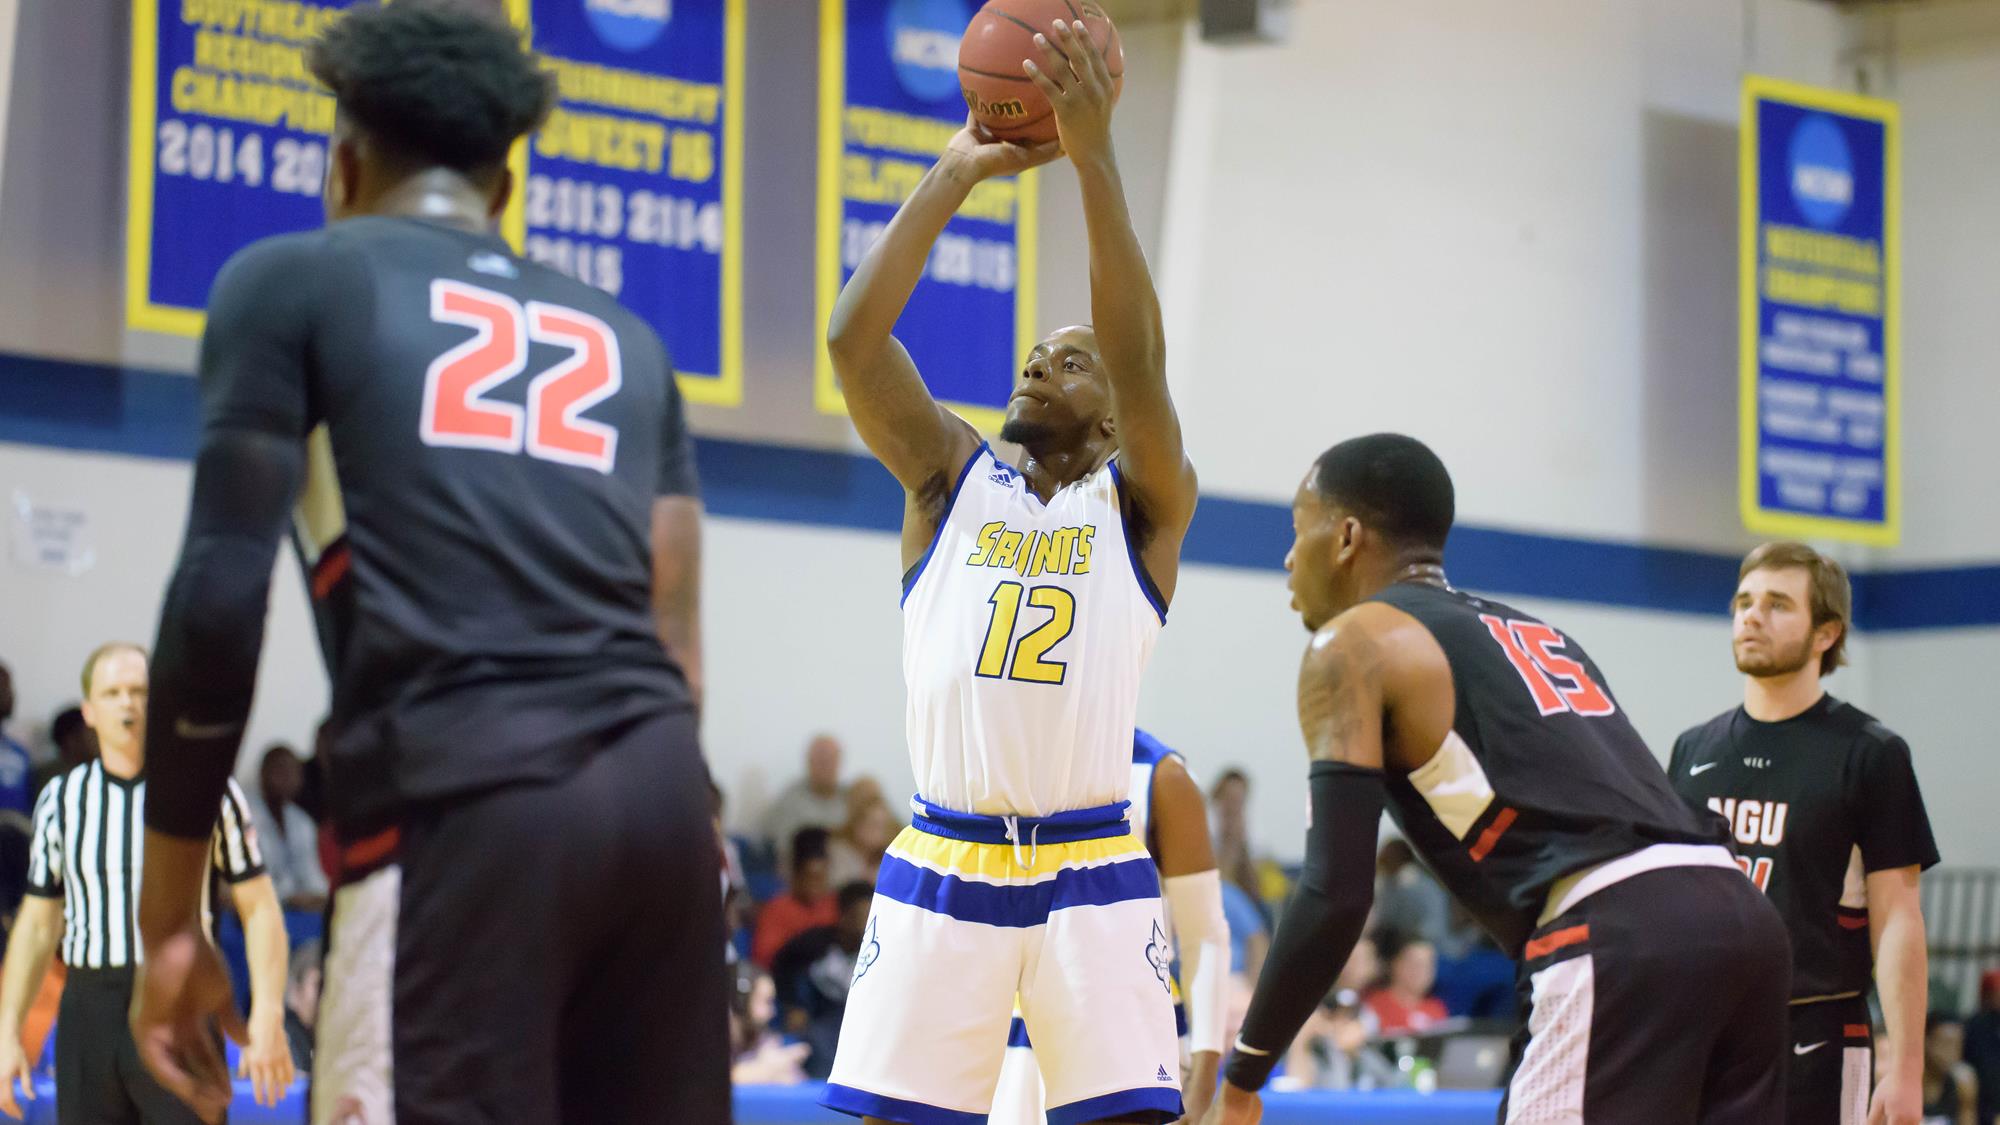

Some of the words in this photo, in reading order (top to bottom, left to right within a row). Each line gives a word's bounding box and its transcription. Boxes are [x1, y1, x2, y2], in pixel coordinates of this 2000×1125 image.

[158, 117, 263, 188] 2014
[419, 277, 622, 475] 22
[966, 521, 1096, 577] SAINTS
[975, 580, 1076, 685] 12
[1478, 613, 1615, 717] 15
